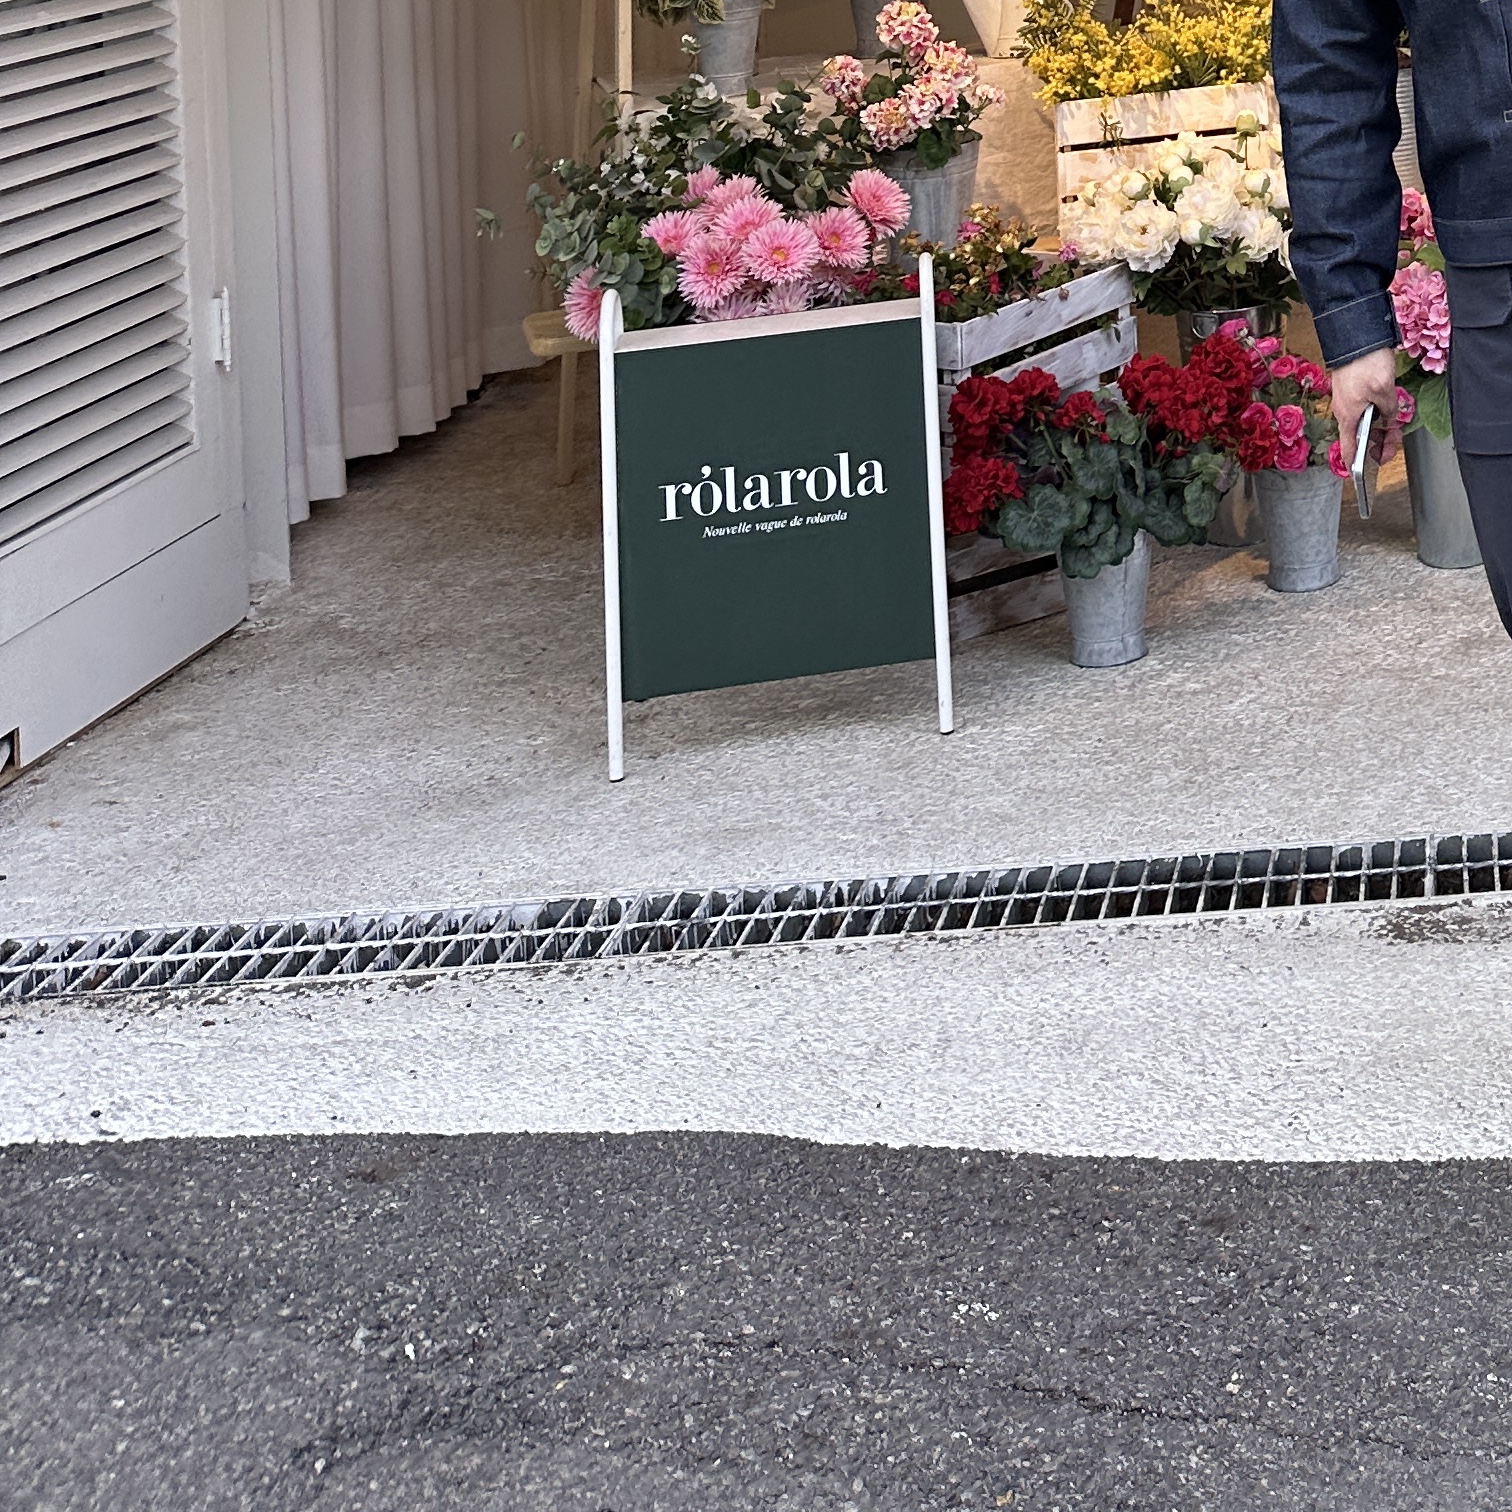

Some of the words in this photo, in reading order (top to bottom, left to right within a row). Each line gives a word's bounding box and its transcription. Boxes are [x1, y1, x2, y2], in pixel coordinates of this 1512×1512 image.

[702, 521, 752, 538] Nouvelle
[755, 518, 786, 533] vague
[789, 515, 803, 527] de
[805, 509, 848, 525] rolarola
